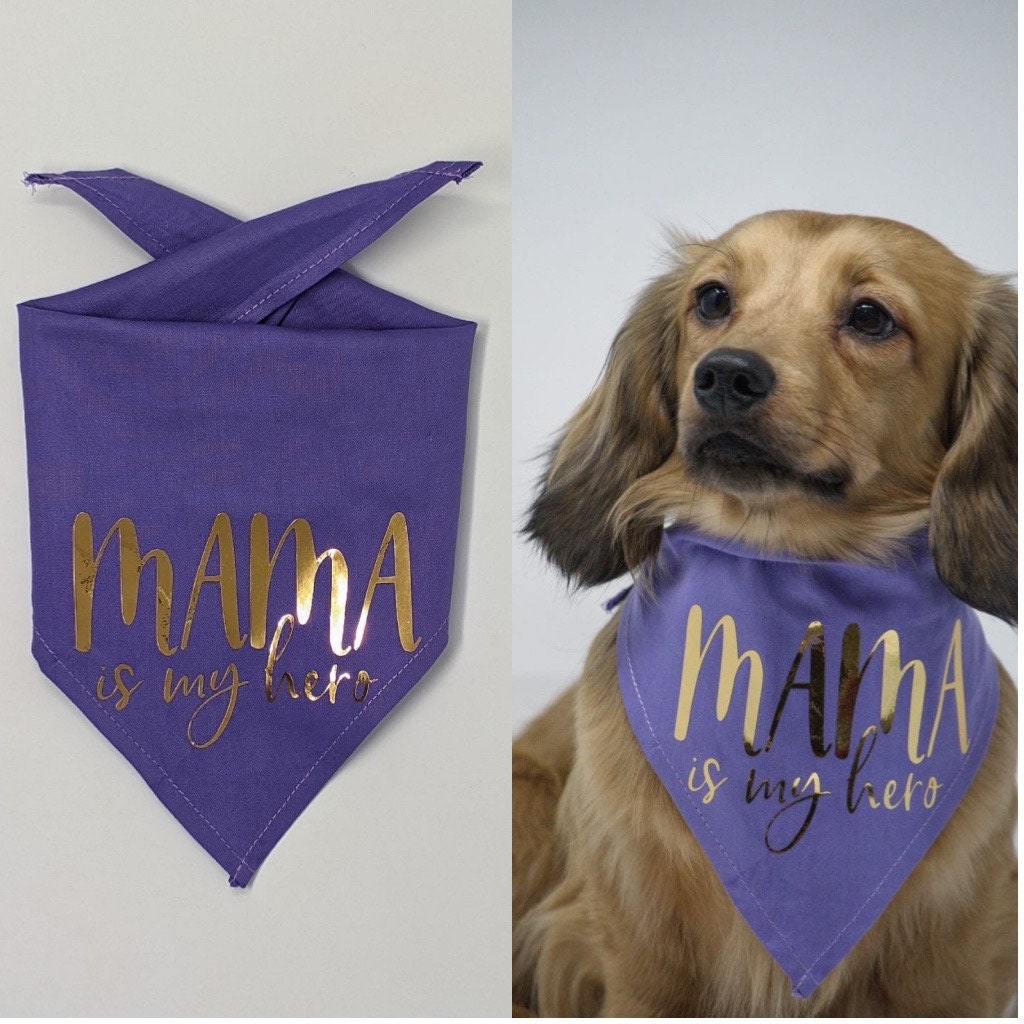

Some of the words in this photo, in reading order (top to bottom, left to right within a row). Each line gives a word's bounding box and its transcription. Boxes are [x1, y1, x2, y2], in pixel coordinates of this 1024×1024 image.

[72, 512, 422, 656] MAMA
[95, 663, 144, 710] is
[163, 662, 250, 749] my
[264, 614, 378, 704] hero
[674, 604, 970, 764] MAMA
[688, 757, 728, 804] is
[745, 768, 831, 853] my
[846, 725, 943, 813] hero
